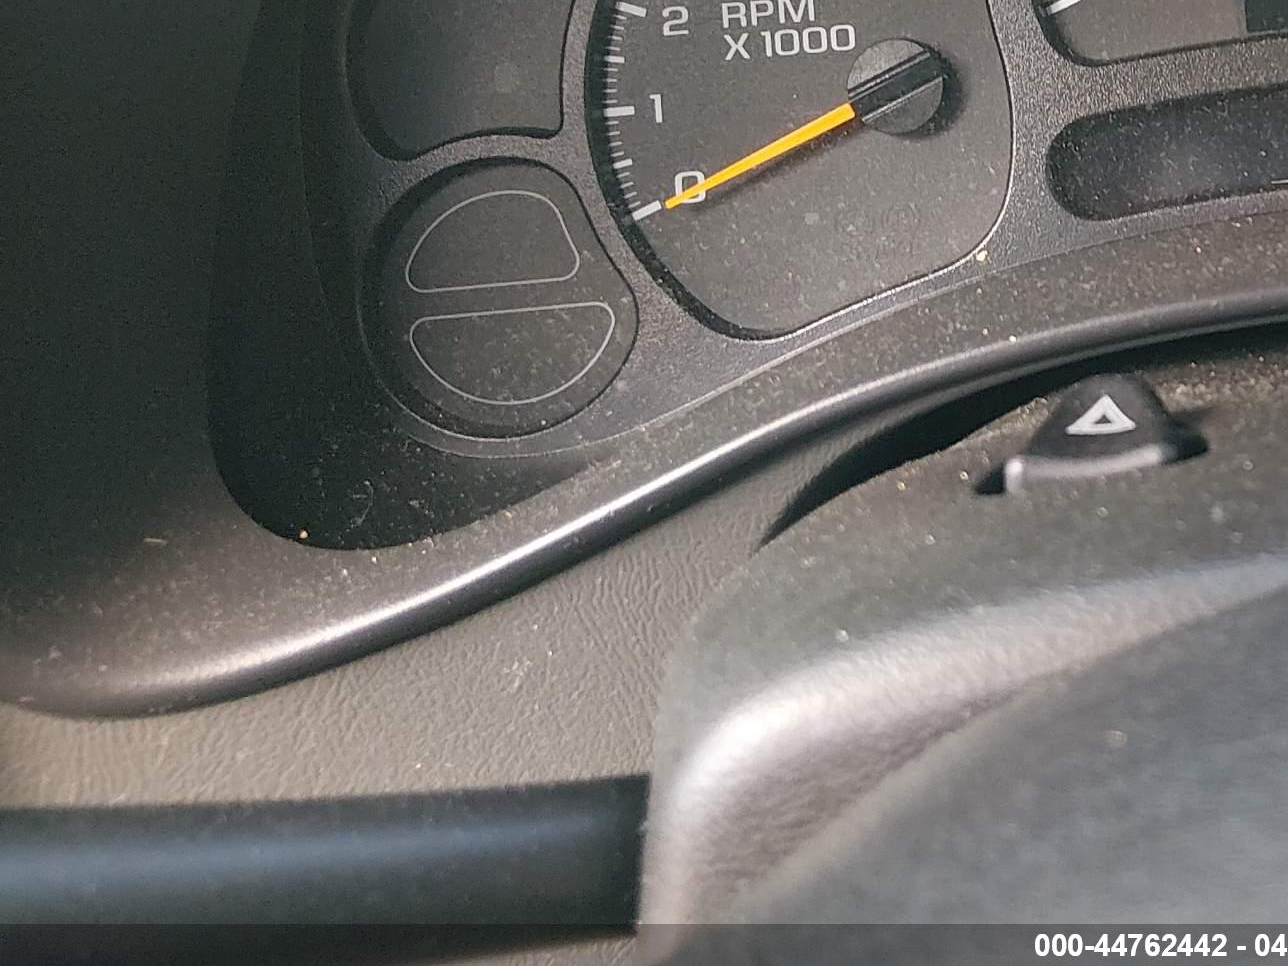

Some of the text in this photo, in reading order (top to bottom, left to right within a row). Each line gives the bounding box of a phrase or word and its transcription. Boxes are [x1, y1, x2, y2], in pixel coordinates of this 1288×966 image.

[662, 6, 689, 36] 2
[723, 24, 856, 61] X 1000
[649, 93, 663, 123] 1
[674, 170, 706, 204] 0
